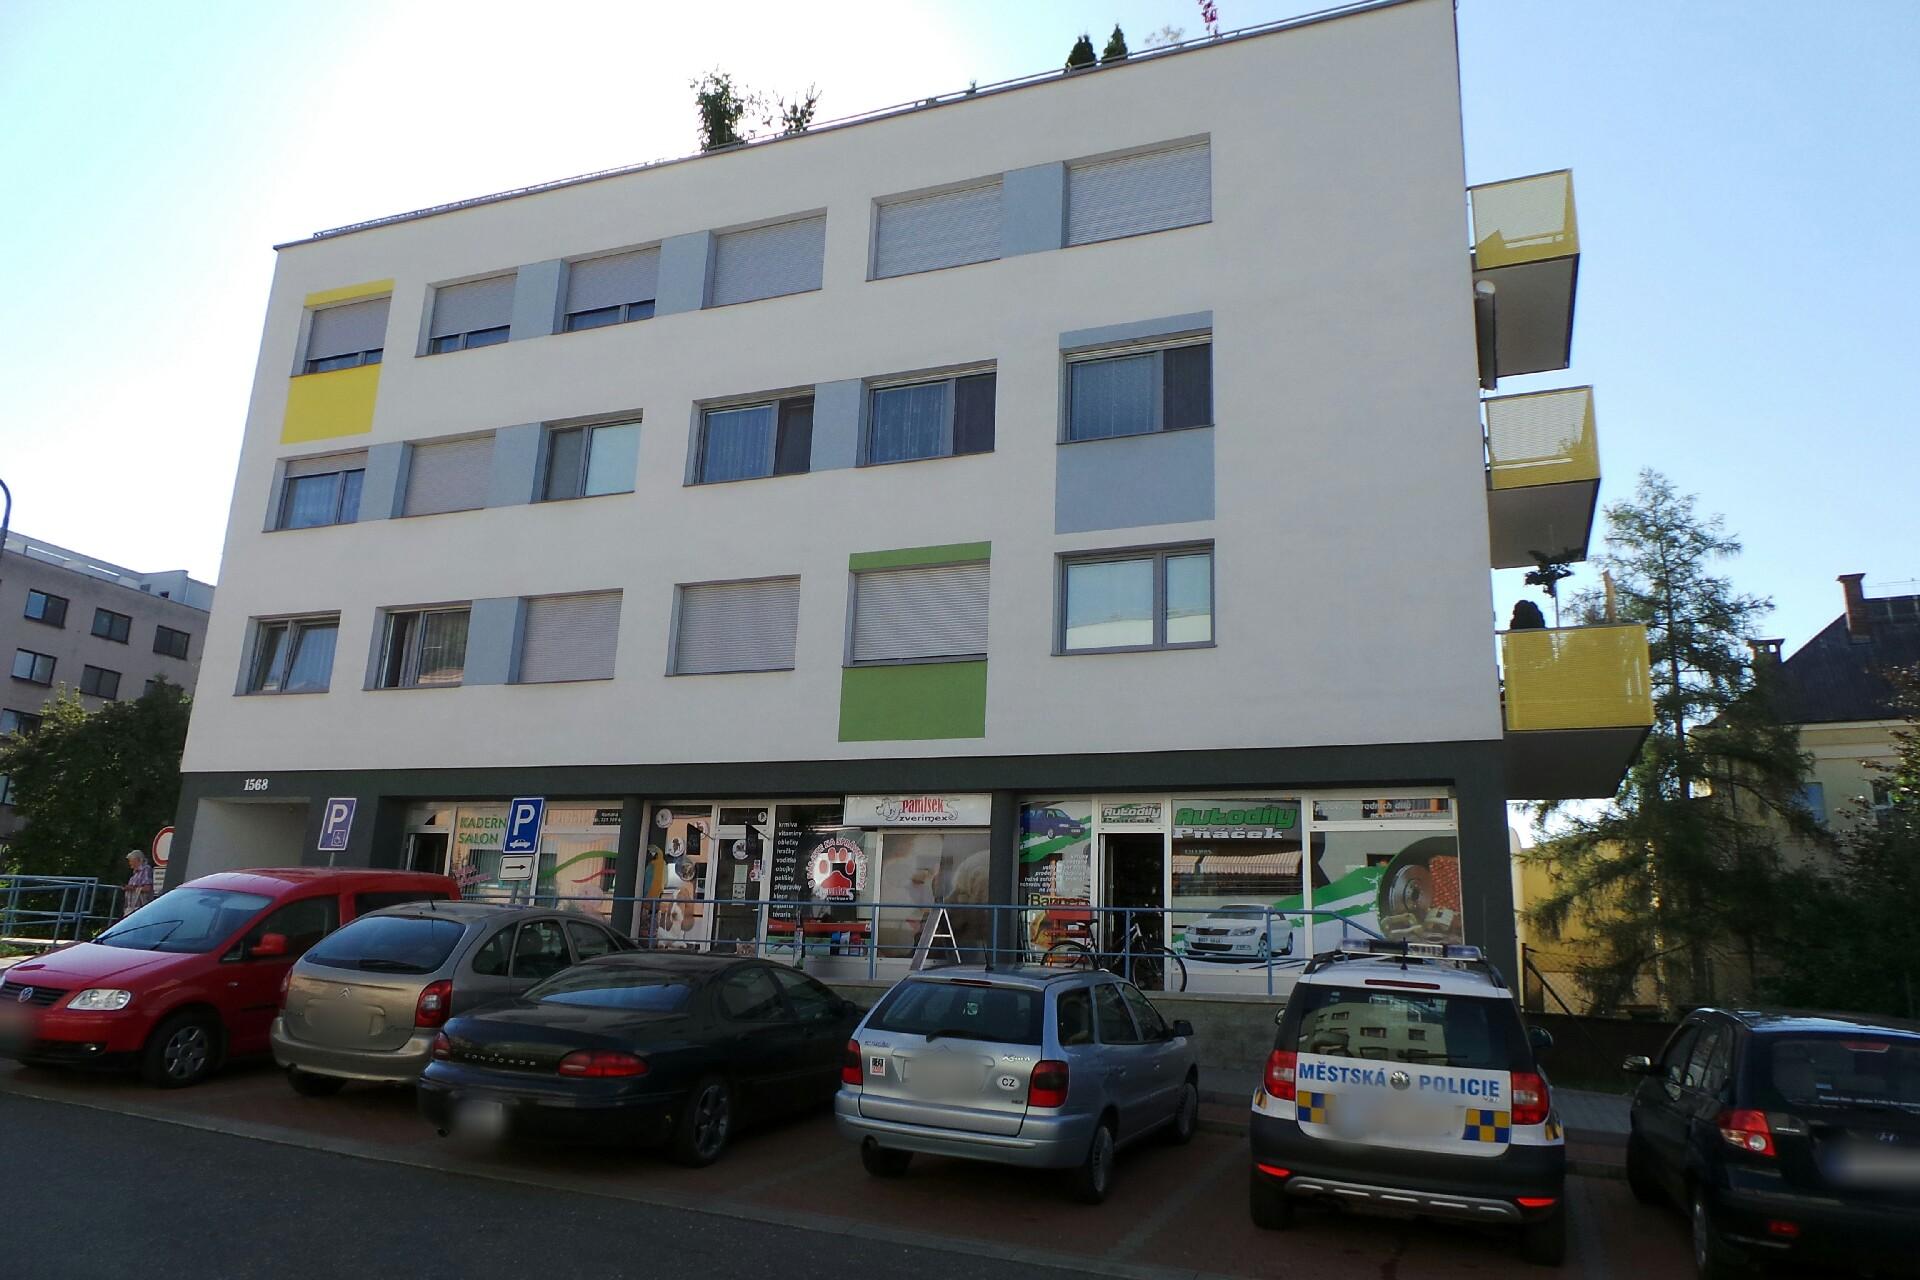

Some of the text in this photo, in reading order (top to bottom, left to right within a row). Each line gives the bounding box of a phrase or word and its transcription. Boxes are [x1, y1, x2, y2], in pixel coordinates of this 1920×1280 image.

[244, 779, 269, 791] 1568
[328, 804, 349, 834] P
[459, 814, 507, 829] KADEŘN
[512, 804, 536, 836] P
[899, 815, 948, 823] zverimex
[458, 833, 499, 845] SALON
[1173, 827, 1283, 839] Pňáček
[1001, 1078, 1016, 1087] CZ
[1299, 1061, 1500, 1098] MĚSTSKÁ POLICIE
